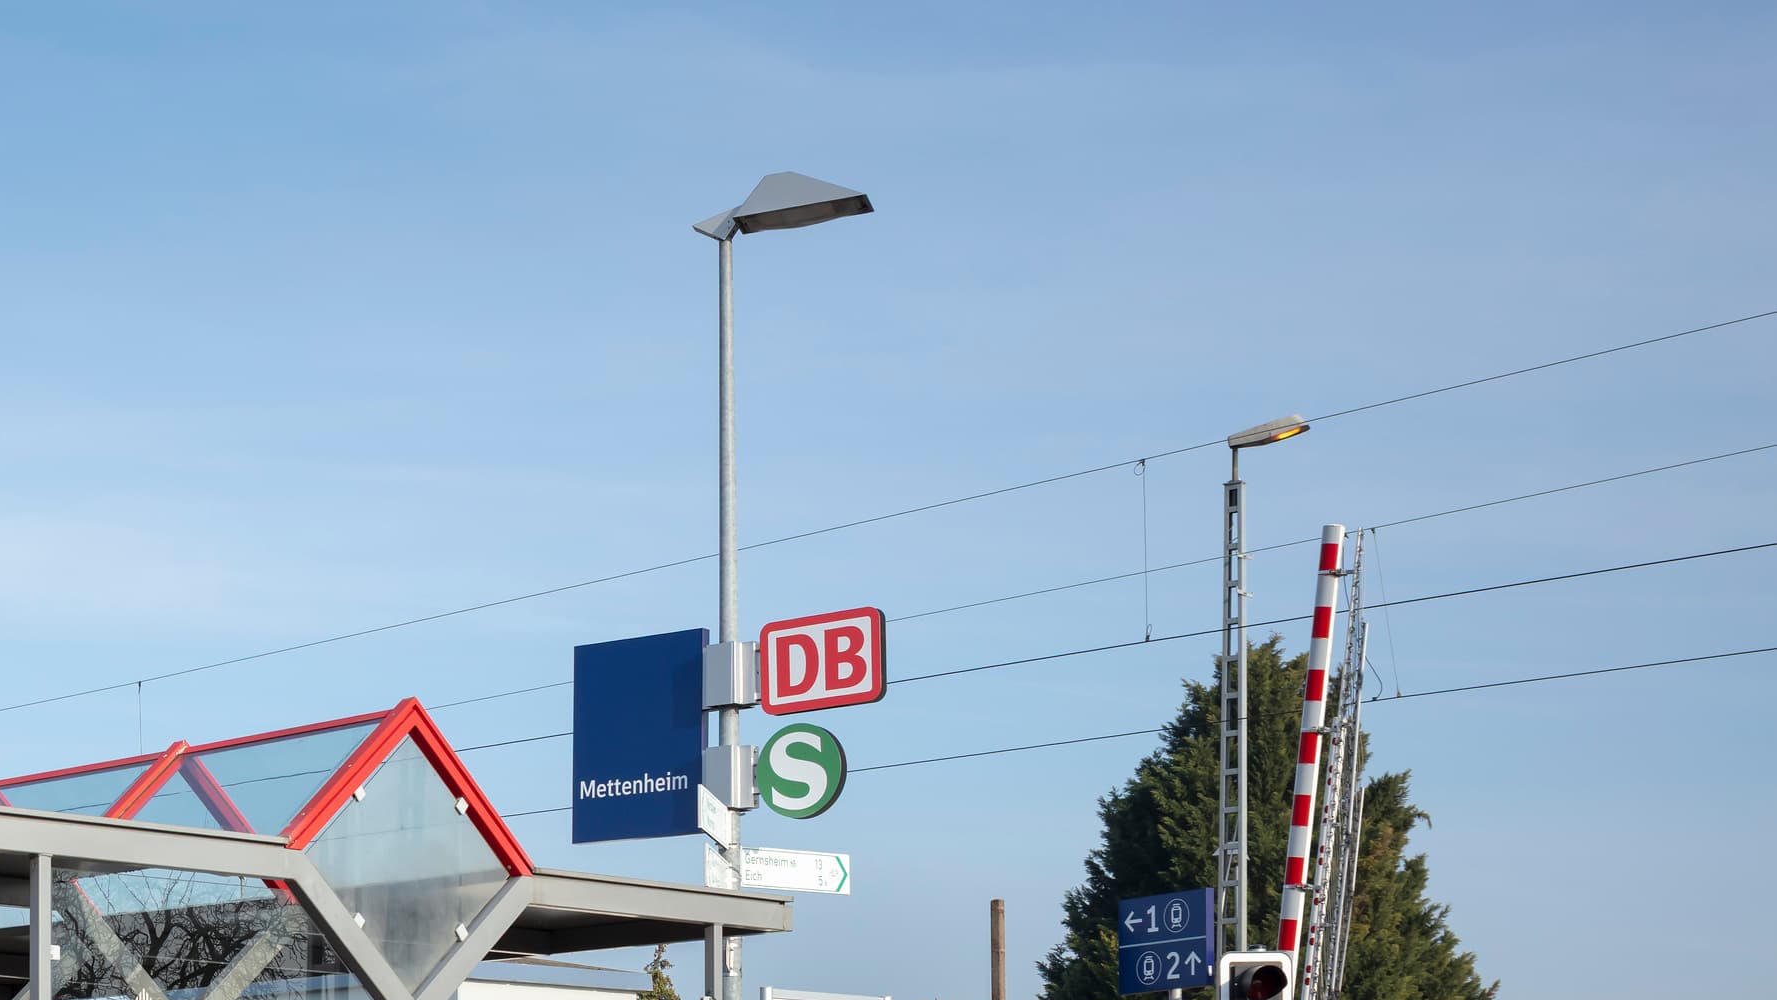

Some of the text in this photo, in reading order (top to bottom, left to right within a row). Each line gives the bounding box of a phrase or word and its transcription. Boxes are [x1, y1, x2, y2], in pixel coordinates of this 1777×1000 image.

[775, 625, 868, 698] DB
[769, 731, 828, 810] S
[579, 771, 689, 800] Mettenheim
[745, 853, 789, 867] Gernsheim
[745, 869, 763, 881] Eich
[1146, 905, 1159, 933] 1
[1166, 951, 1180, 980] 2
